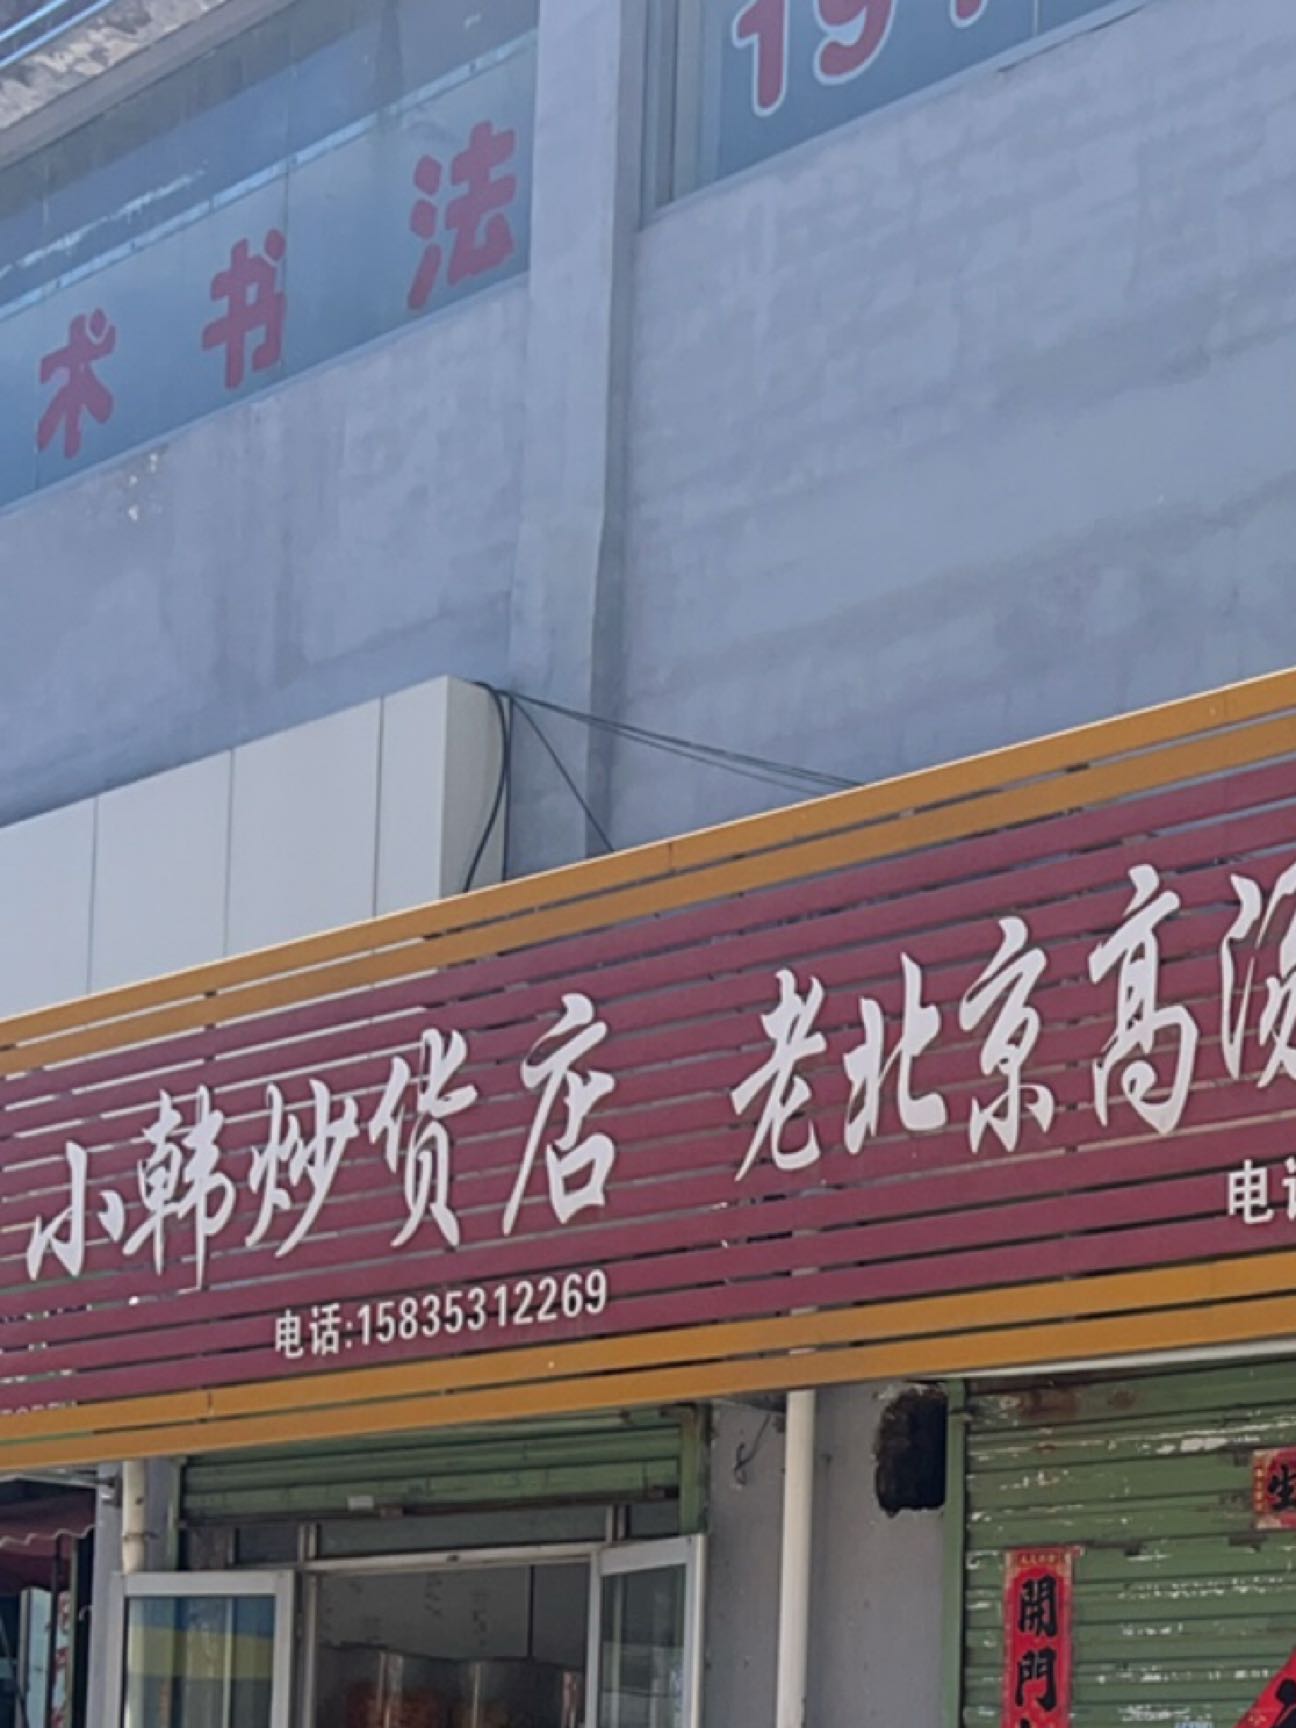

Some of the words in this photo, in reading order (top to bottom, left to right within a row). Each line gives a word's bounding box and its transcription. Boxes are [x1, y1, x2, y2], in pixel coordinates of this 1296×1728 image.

[732, 0, 985, 117] 19
[37, 120, 517, 459] 术书法
[26, 993, 615, 1291] 小韩炒货店
[273, 1269, 608, 1359] 电话:15835312269
